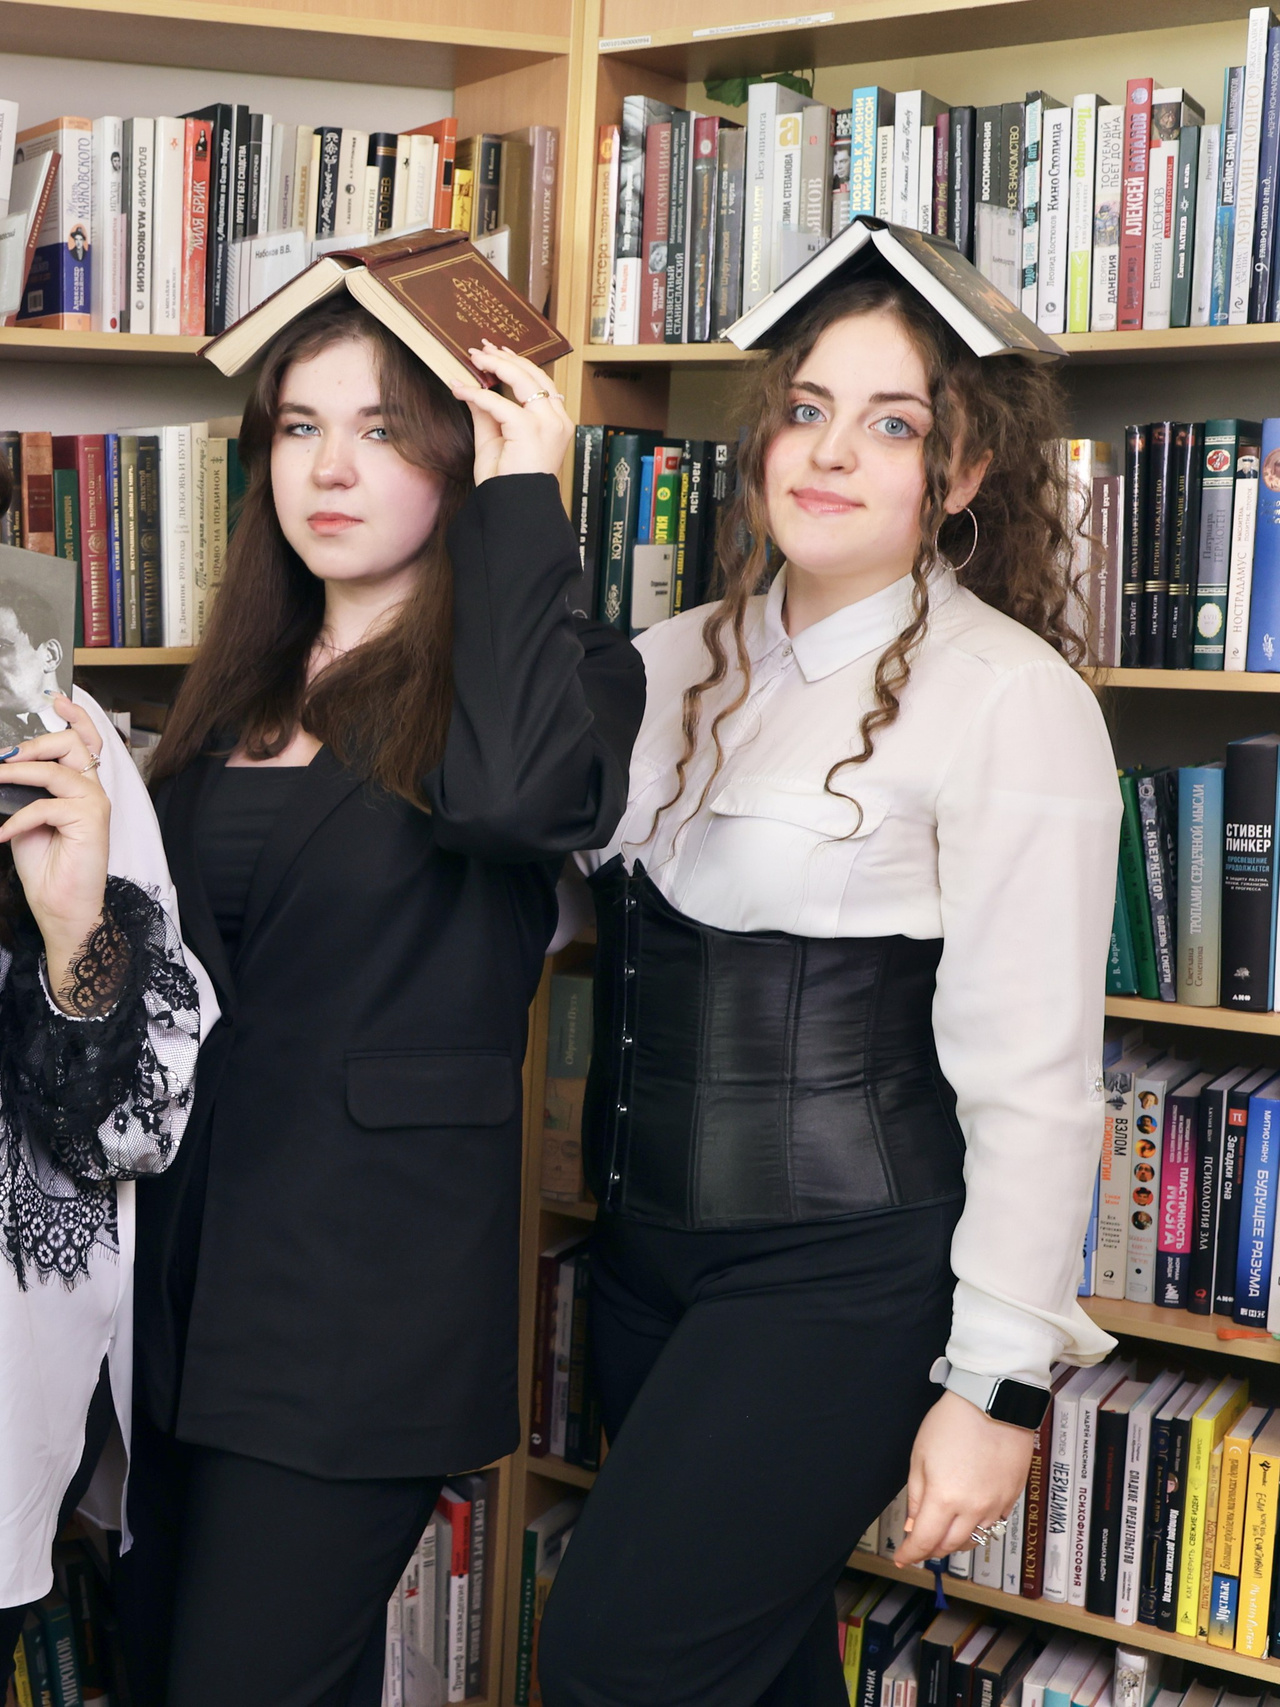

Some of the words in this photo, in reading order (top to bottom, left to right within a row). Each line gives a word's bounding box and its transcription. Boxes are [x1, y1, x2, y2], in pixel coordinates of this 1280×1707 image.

[758, 112, 767, 158] эпилога
[855, 97, 866, 142] ЖИЗНИ
[864, 96, 874, 176] ФРЕДРИКССОН
[1129, 113, 1147, 172] БАТАЛОВ
[1225, 132, 1236, 160] БОНД
[1248, 84, 1260, 155] МОНРО
[77, 137, 91, 220] МАЯКОВСКОГО
[138, 146, 147, 208] ВЛАДИМИР
[755, 161, 765, 180] Без
[783, 153, 793, 199] СТЕПАНОВА
[853, 155, 864, 211] ЛЮБОВЬ
[982, 122, 992, 201] ВОСПОМИНАНИЯ
[1100, 122, 1111, 188] ТОСТУЕМЫЙ
[1223, 162, 1235, 203] ДЖЕЙМС
[194, 180, 206, 215] БРИК
[656, 166, 668, 236] НИКУЛИН
[862, 178, 872, 211] МАРИ
[1125, 177, 1144, 236] АЛЕКСЕЙ
[136, 210, 145, 293] МАЯКОВСКИЙ
[192, 216, 205, 250] ЛИЛЯ
[592, 242, 608, 307] Мастера
[665, 264, 674, 335] НЕИЗВЕСТНЫЙ
[673, 252, 684, 335] СТАНИСЛАВСКИЙ
[1107, 254, 1117, 304] ДАНЕЛИЯ
[452, 278, 520, 342] ФРЭЗЕР
[611, 521, 624, 560] КОРАН
[1232, 552, 1247, 633] НОСТРАДАМУС
[1193, 784, 1204, 825] МЫСЛИ
[1226, 823, 1272, 838] СТИВЕН
[1190, 827, 1203, 883] СЕРДЕЧНОЙ
[1226, 838, 1271, 853] ПИНКЕР
[1190, 886, 1202, 935] ТРОПАМИ
[1101, 1116, 1114, 1181] ПСИХОЛОГИИ
[1114, 1117, 1128, 1156] ВЗЛОМ
[1225, 1134, 1237, 1178] Загадки
[1176, 1168, 1189, 1249] ПЛАСТИЧНОСТЬ
[1200, 1156, 1213, 1227] ПСИХОЛОГИЯ
[1224, 1180, 1232, 1200] сна
[1252, 1170, 1269, 1238] БУДУЩЕЕ
[1199, 1229, 1209, 1250] ЗЛА
[1248, 1240, 1264, 1298] РАЗУМА
[1030, 1455, 1042, 1501] ВОЙНЫ
[1049, 1461, 1070, 1534] НЕВИДИМКА
[1129, 1470, 1139, 1502] СЛАДКОЕ
[1026, 1503, 1038, 1579] ИСКУССТВО
[1074, 1487, 1087, 1587] ПСИХОФИЛОСОФИЯ
[1124, 1503, 1137, 1564] ПРЕДАТЕЛЬСТВО
